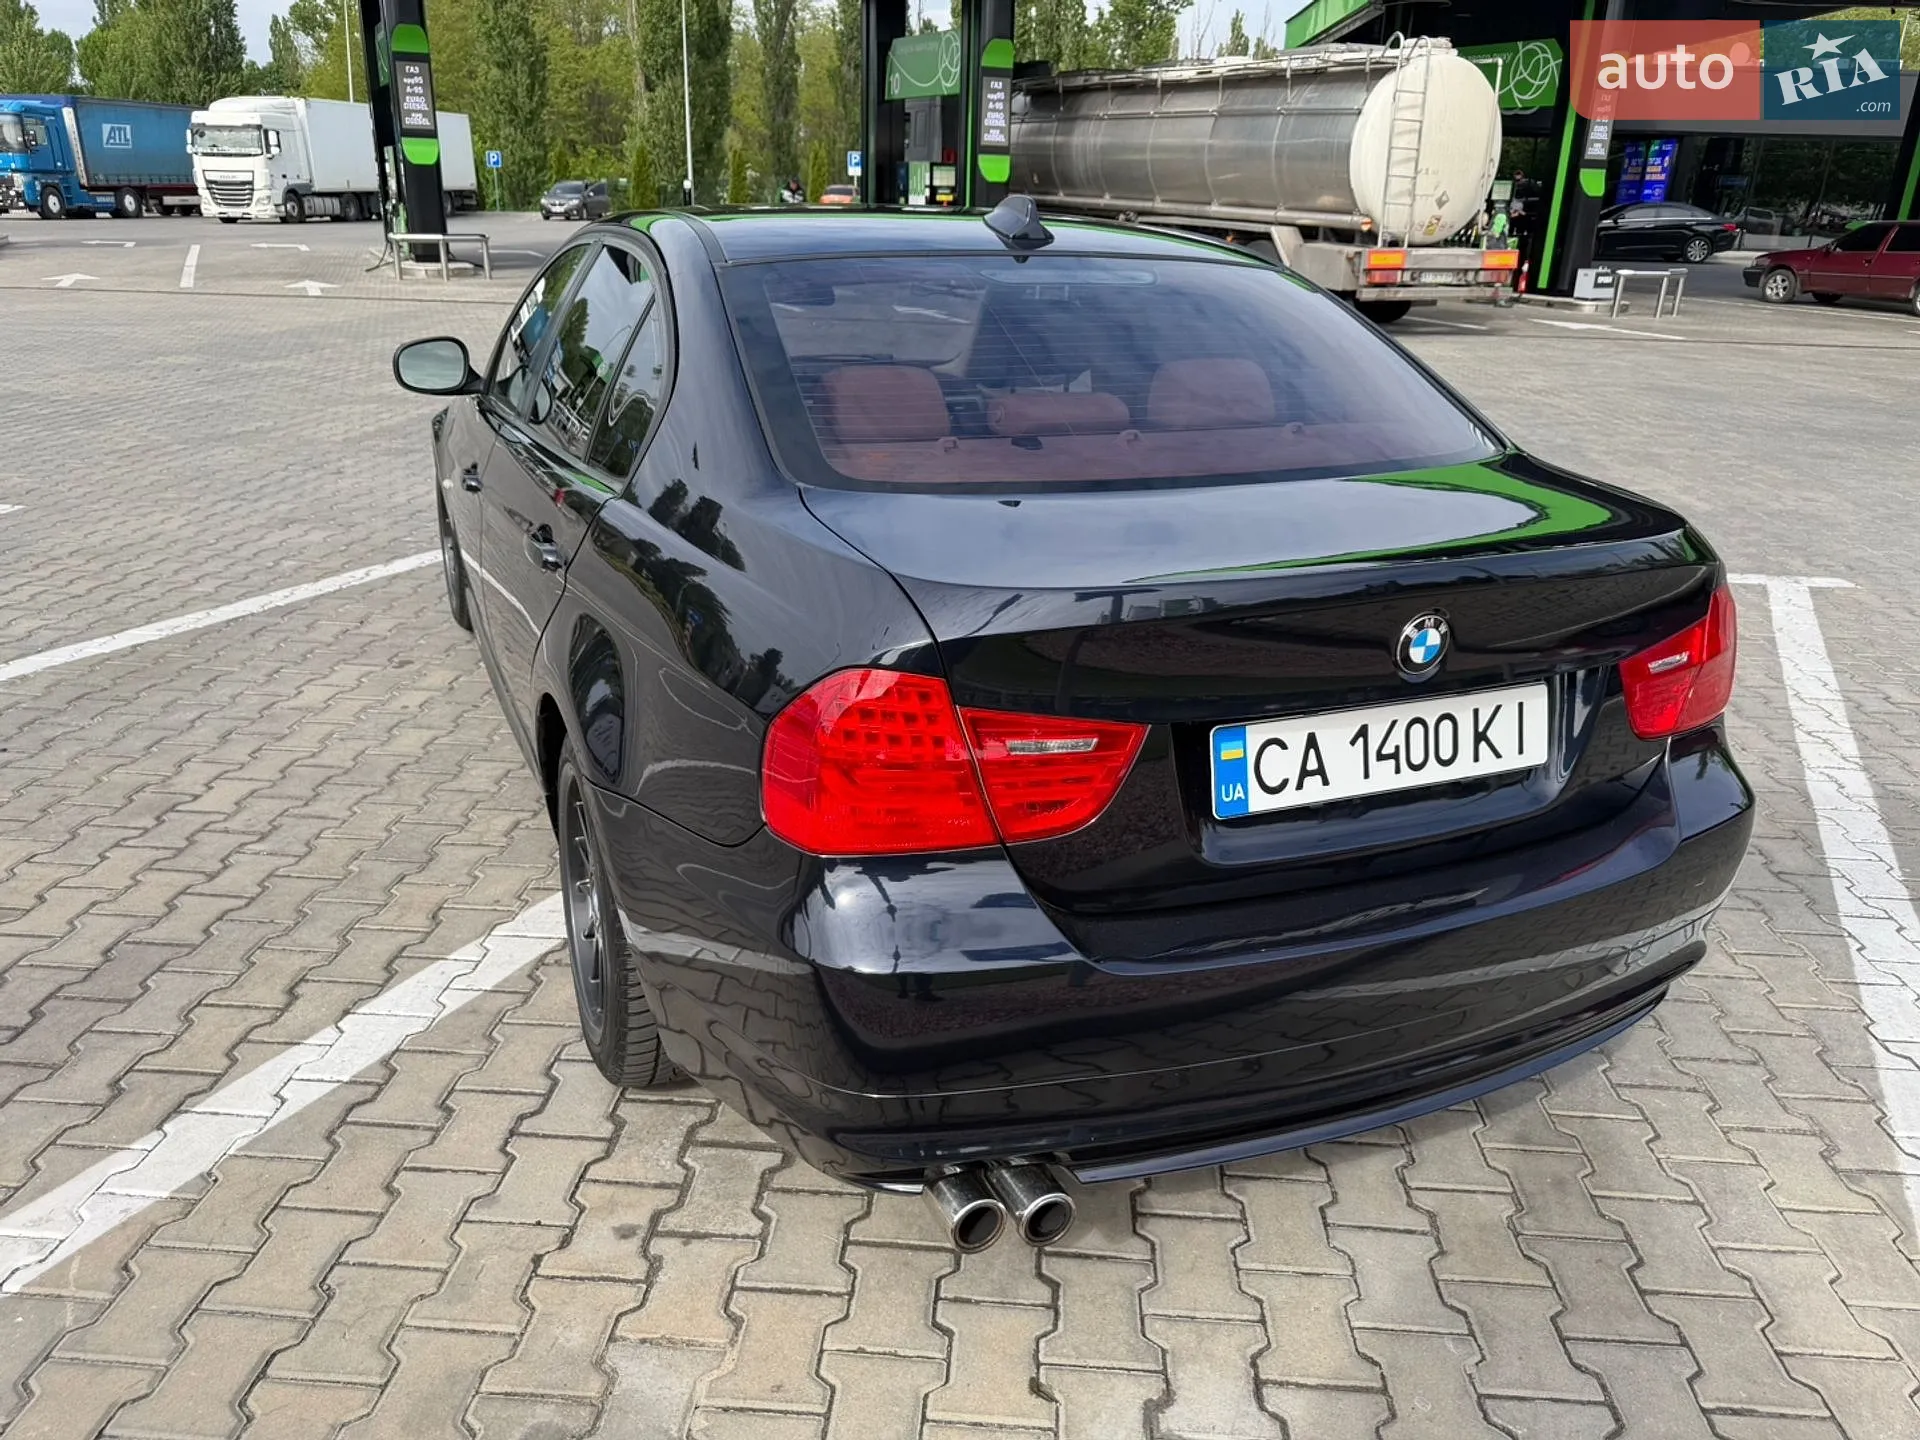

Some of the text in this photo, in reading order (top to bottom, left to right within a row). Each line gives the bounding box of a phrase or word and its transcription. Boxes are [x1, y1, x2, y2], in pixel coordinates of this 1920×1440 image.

[890, 72, 900, 95] 10
[403, 102, 429, 110] DIESEL
[105, 125, 131, 145] ATL
[490, 152, 498, 165] P
[850, 154, 860, 167] P
[1406, 617, 1448, 639] BMW
[1254, 701, 1524, 795] CA 1400 KI
[1221, 783, 1246, 802] UA
